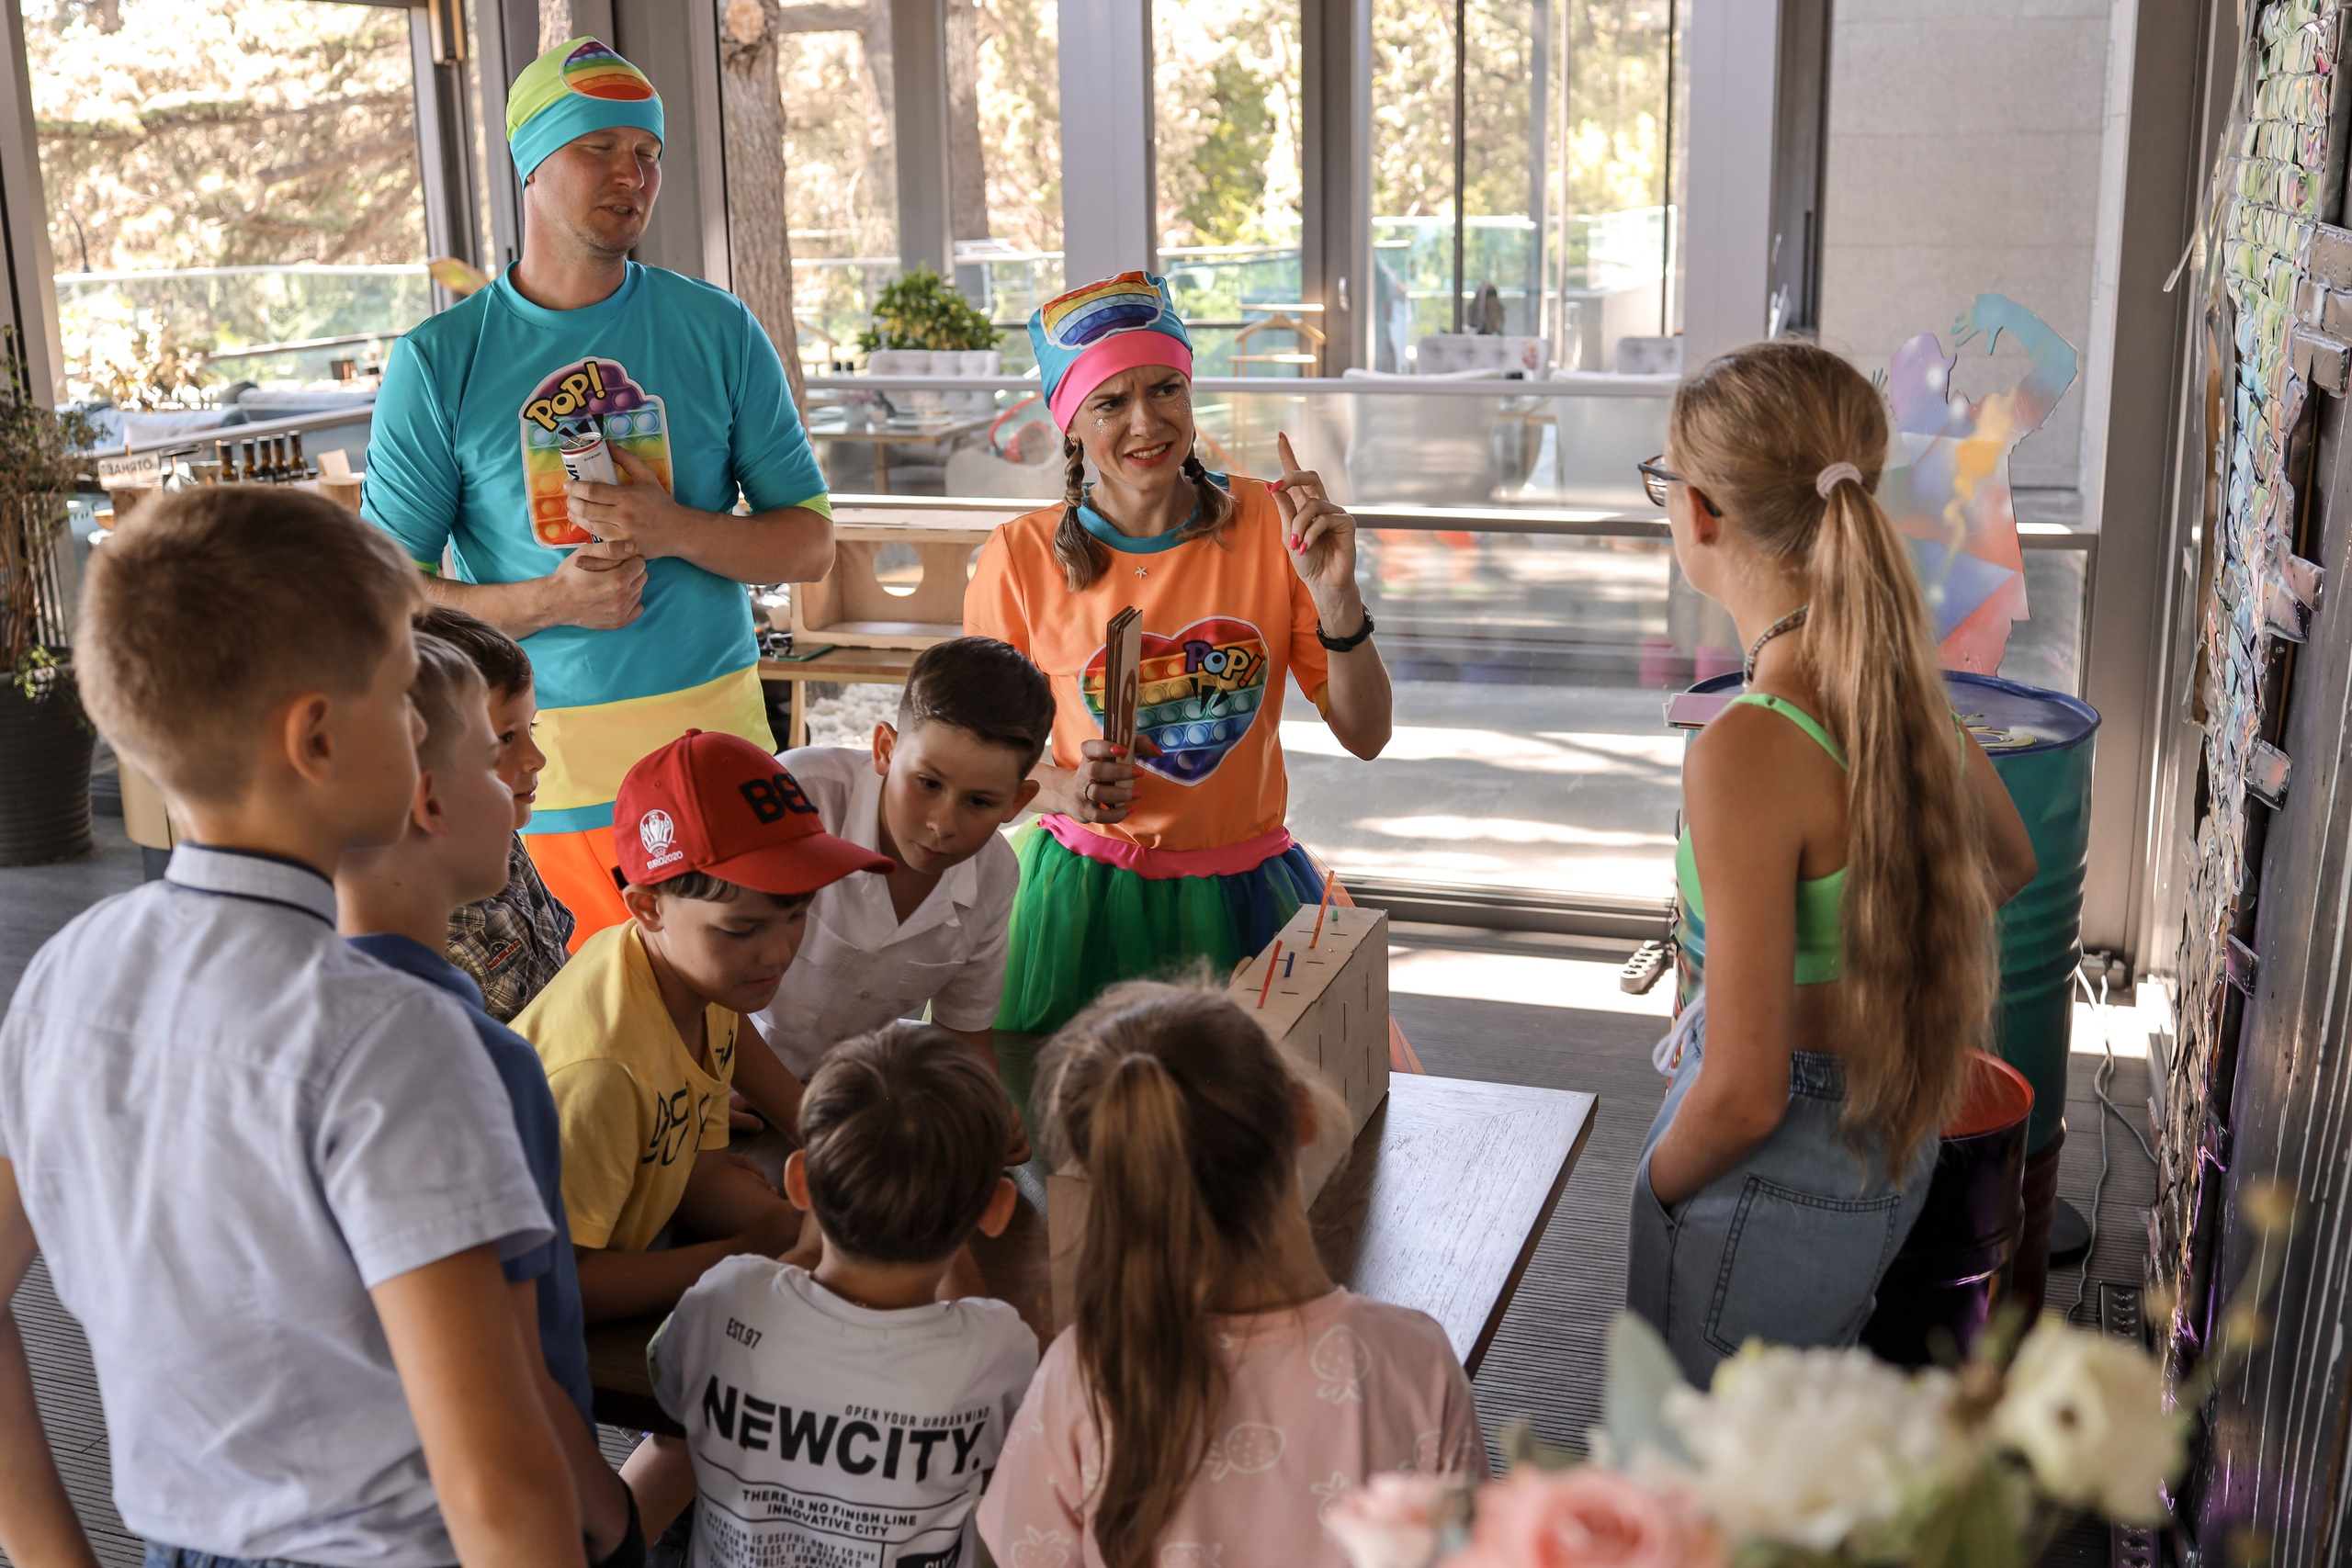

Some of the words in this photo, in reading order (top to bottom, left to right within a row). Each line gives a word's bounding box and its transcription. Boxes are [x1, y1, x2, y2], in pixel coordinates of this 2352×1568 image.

[524, 361, 606, 432] POP!
[1182, 640, 1263, 689] POP!
[726, 1316, 762, 1349] EST.97
[703, 1375, 985, 1483] NEWCITY.
[845, 1404, 878, 1421] OPEN
[884, 1411, 917, 1427] YOUR
[922, 1414, 962, 1427] URBAN
[965, 1405, 989, 1423] MIND
[742, 1489, 788, 1504] THERE
[792, 1497, 804, 1508] IS
[808, 1502, 829, 1514] NO
[832, 1505, 881, 1524] FINISH
[884, 1514, 917, 1527] LINE
[767, 1504, 851, 1532] INNOVATIVE
[855, 1524, 888, 1537] CITY
[743, 1544, 782, 1557] UNLESS
[786, 1543, 797, 1553] IT
[801, 1545, 811, 1554] IS
[752, 1535, 763, 1545] IS
[768, 1532, 805, 1544] USEFUL
[811, 1540, 836, 1552] ONLY
[842, 1548, 854, 1557] TO
[858, 1551, 876, 1562] THE
